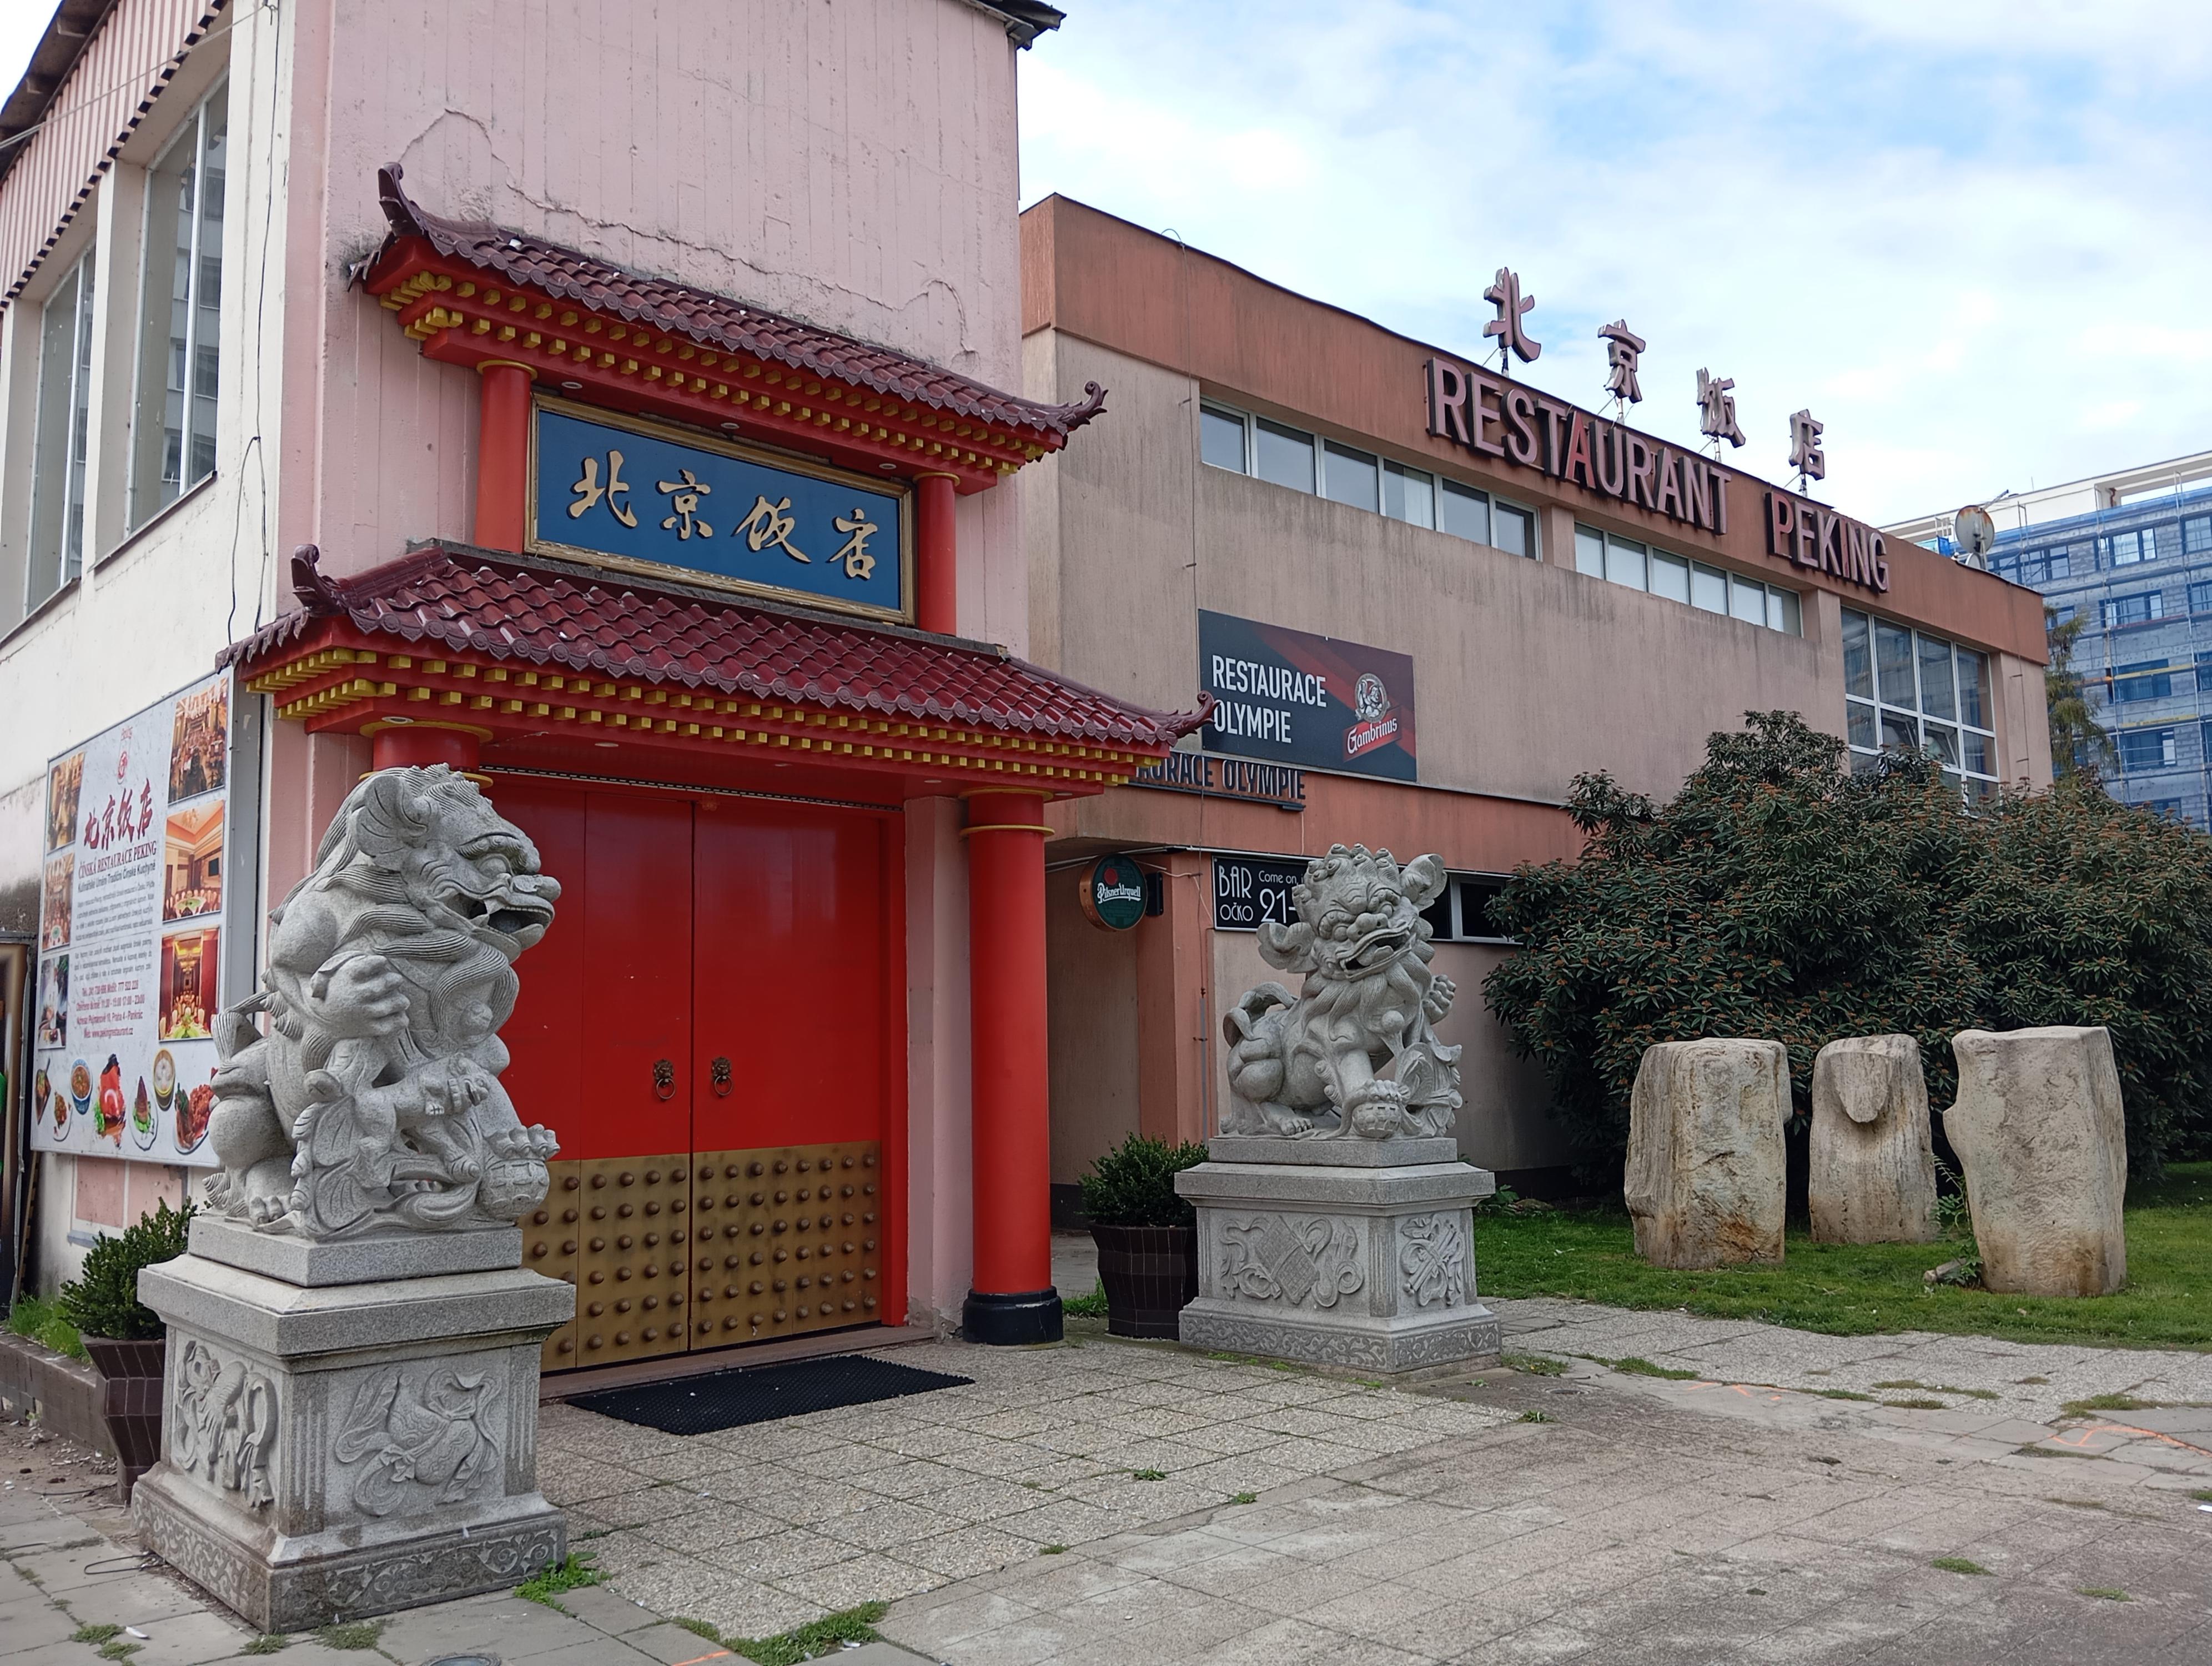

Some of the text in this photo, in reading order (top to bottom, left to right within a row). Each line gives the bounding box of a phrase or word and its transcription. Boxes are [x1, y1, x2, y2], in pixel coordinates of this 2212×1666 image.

[1424, 357, 1890, 593] RESTAURANT PEKING
[1212, 654, 1327, 707] RESTAURACE
[1214, 699, 1292, 744] OLYMPIE
[1347, 717, 1398, 754] Gambrinus
[1221, 759, 1306, 800] OLYMPIE
[97, 849, 132, 873] RESTAURACE
[133, 840, 157, 861] PEKING
[1097, 882, 1141, 904] Pilsner Urquell
[1218, 865, 1252, 899] BAR
[1258, 870, 1283, 883] Come
[1285, 875, 1299, 886] on,
[1220, 902, 1253, 921] OČKO
[1259, 888, 1296, 924] 21-
